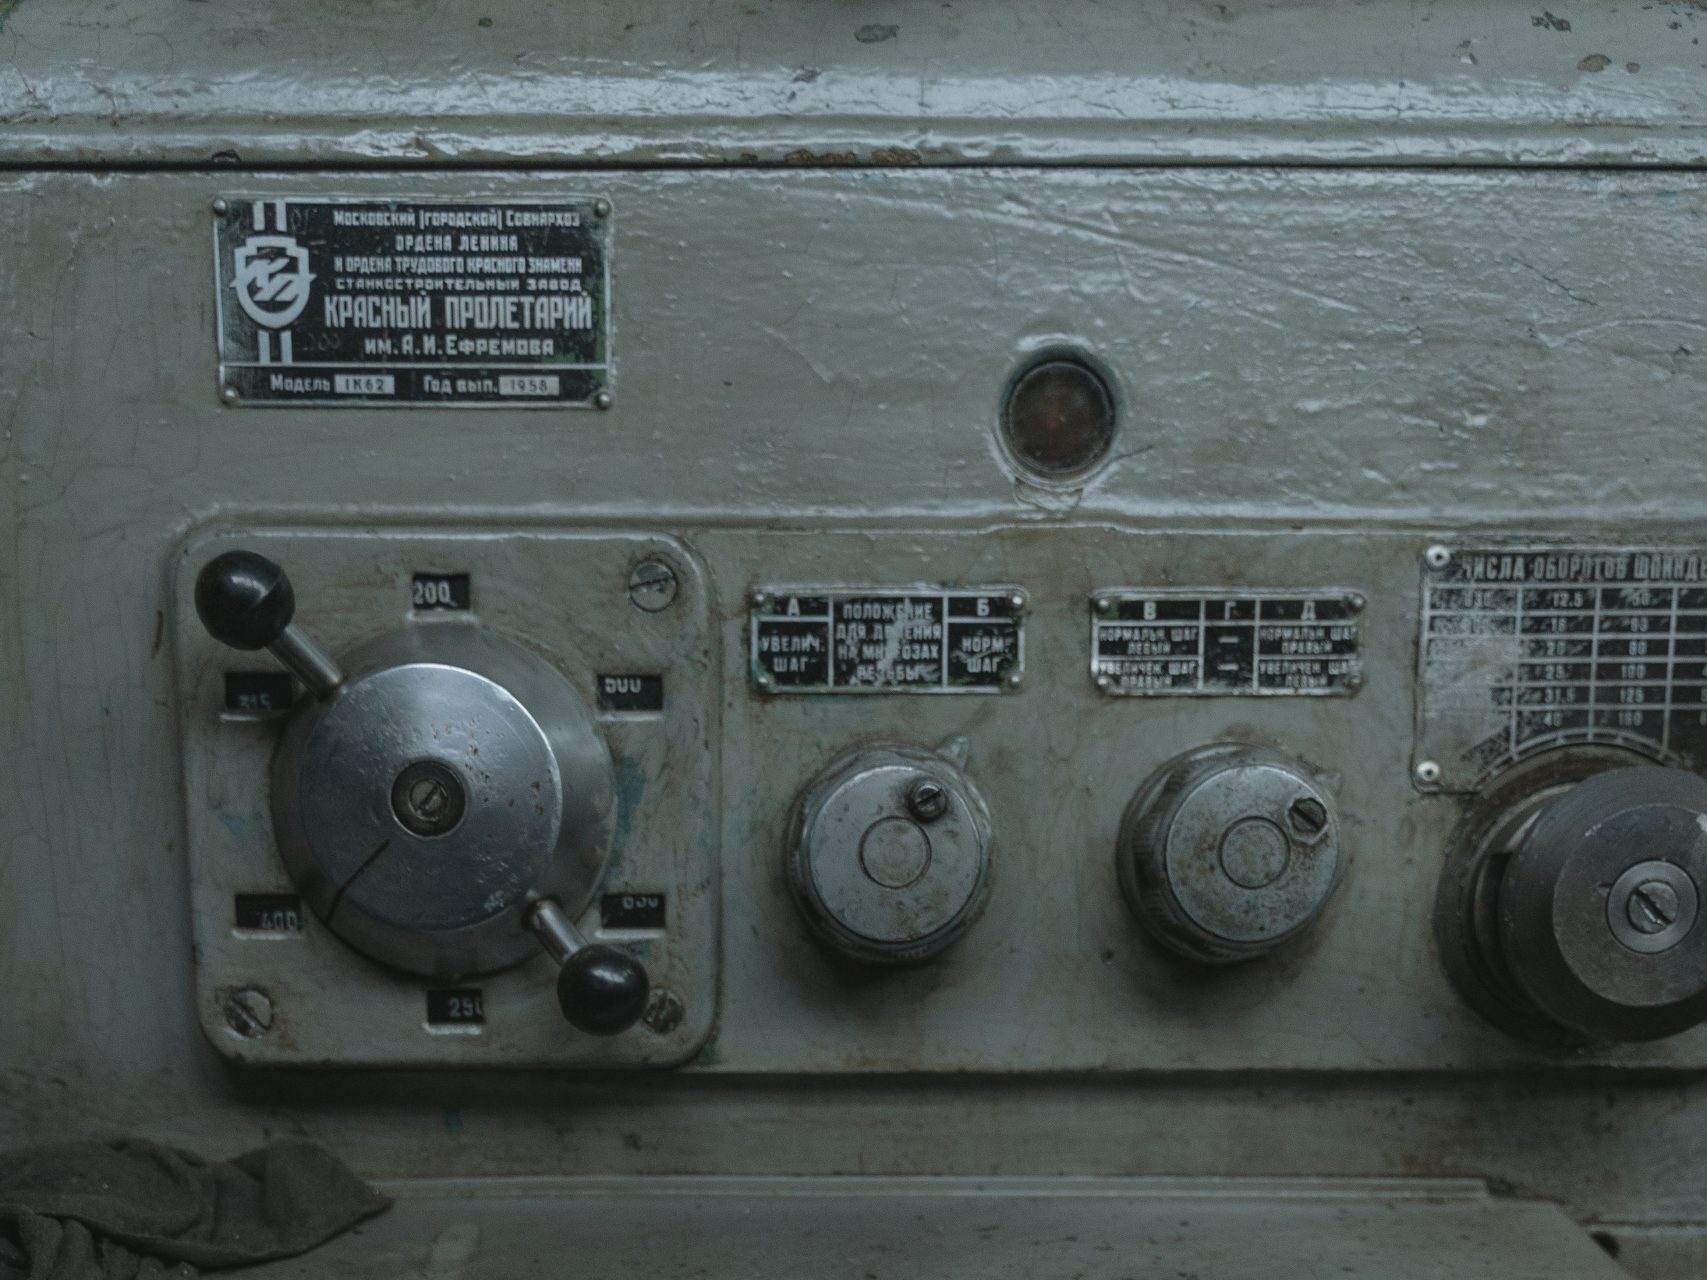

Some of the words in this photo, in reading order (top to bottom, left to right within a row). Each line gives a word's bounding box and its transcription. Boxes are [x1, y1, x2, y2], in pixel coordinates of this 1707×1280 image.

[395, 234, 452, 253] ОРДЕНА
[458, 234, 518, 252] ЛЕНИНА
[345, 256, 392, 275] ОРДЕНА
[395, 256, 464, 275] ТРУДОВОГО
[466, 256, 525, 274] КРАСНОГО
[527, 256, 582, 274] ЗНАМЕНИ
[324, 290, 432, 328] КРАСНЫЙ
[445, 290, 592, 330] ПРОЛЕТАРИЙ
[270, 373, 330, 394] Модель
[423, 374, 452, 395] Год
[456, 378, 498, 393] вып.
[511, 379, 548, 393] 1958
[415, 580, 451, 605] 200
[787, 598, 800, 616] А
[976, 599, 990, 616] Б
[773, 655, 808, 672] ШАГ
[967, 655, 1001, 673] ШАГ
